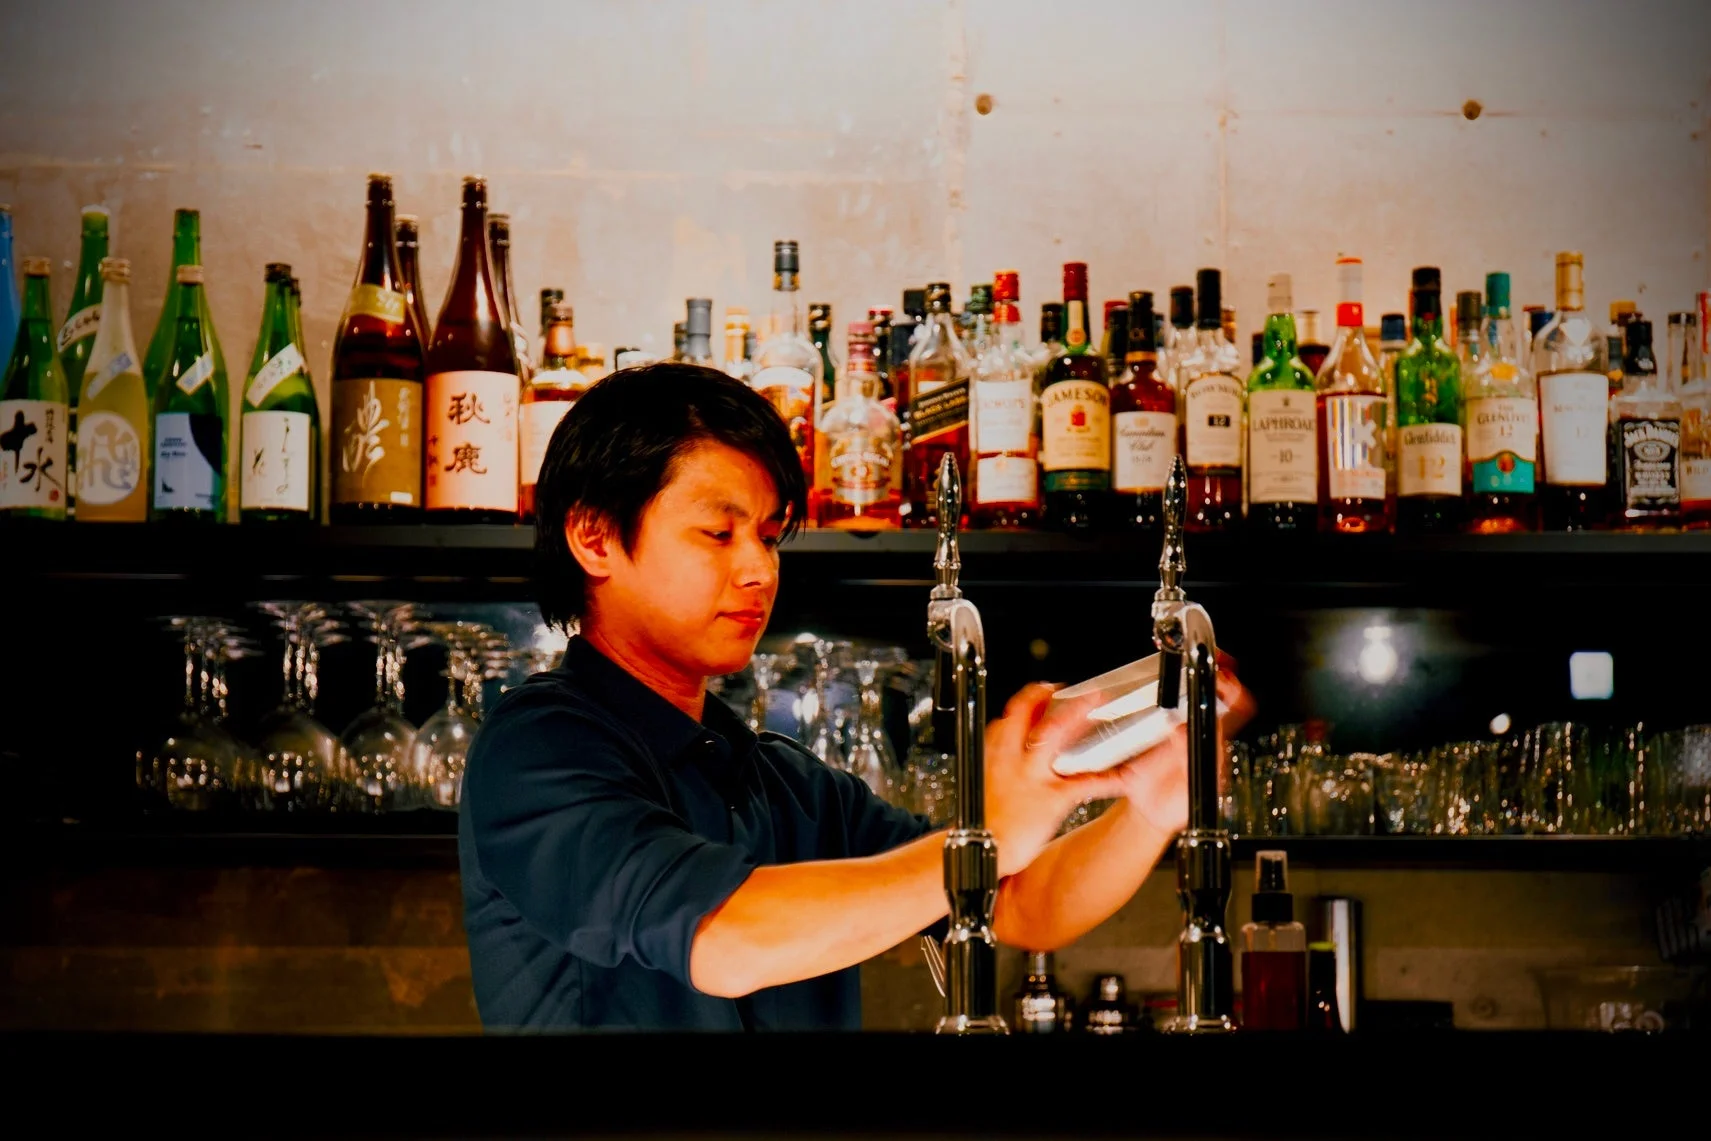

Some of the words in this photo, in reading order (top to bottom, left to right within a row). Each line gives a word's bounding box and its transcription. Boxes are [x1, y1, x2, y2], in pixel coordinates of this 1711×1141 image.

[445, 392, 490, 474] 秋鹿
[1280, 448, 1293, 463] 10
[1419, 455, 1445, 480] 12
